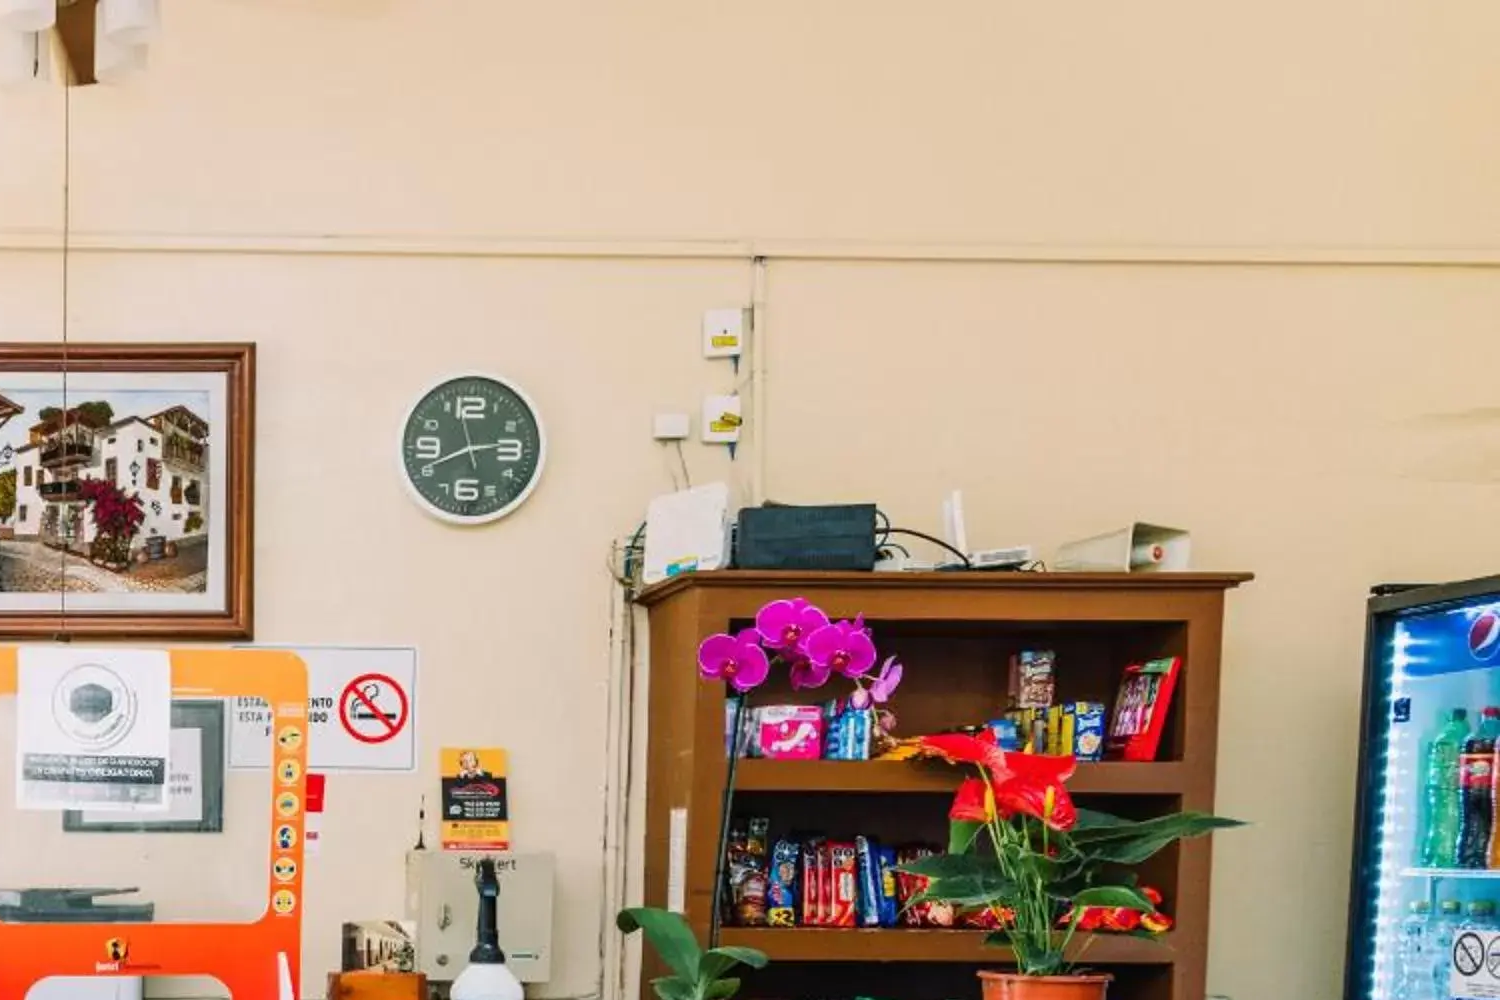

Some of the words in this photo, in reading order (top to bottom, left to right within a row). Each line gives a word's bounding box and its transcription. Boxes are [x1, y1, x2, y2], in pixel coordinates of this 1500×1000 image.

[455, 396, 486, 420] 12
[415, 436, 441, 459] 9
[496, 438, 523, 462] 3
[453, 479, 480, 501] 6
